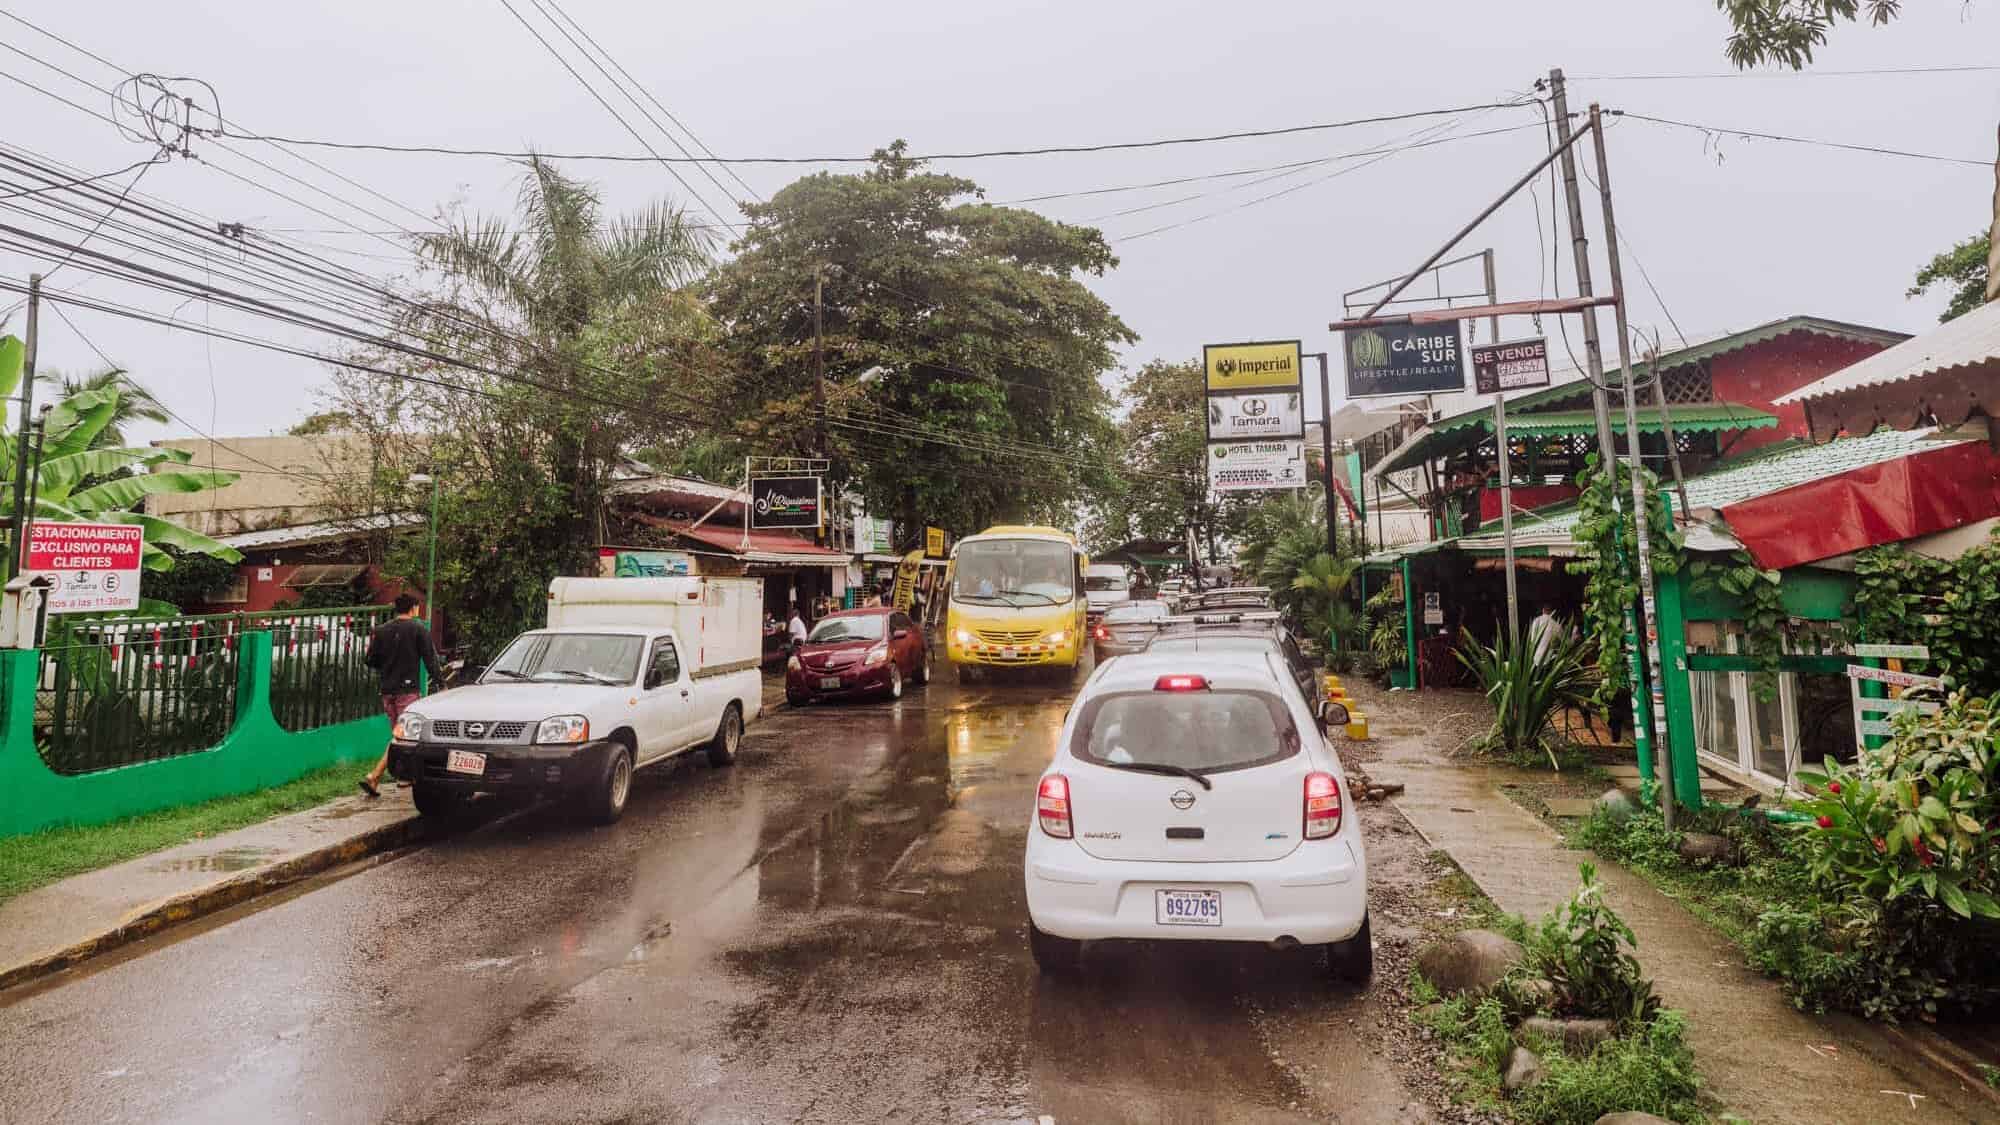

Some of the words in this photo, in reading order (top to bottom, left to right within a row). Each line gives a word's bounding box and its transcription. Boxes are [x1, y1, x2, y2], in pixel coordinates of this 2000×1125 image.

[1391, 335, 1455, 352] CARIBE
[1421, 349, 1457, 363] SUR
[1474, 351, 1493, 364] SE
[1496, 344, 1545, 361] VENDE
[1239, 355, 1291, 375] Imperial
[1230, 415, 1280, 426] Tamara
[1228, 445, 1253, 454] HOTEL
[1256, 443, 1288, 453] TAMARA
[30, 541, 101, 553] EXCLUSIVO
[103, 542, 134, 554] PARA
[52, 556, 113, 568] CLIENTES
[106, 576, 116, 589] E
[78, 598, 91, 608] las
[1167, 898, 1217, 917] 892785
